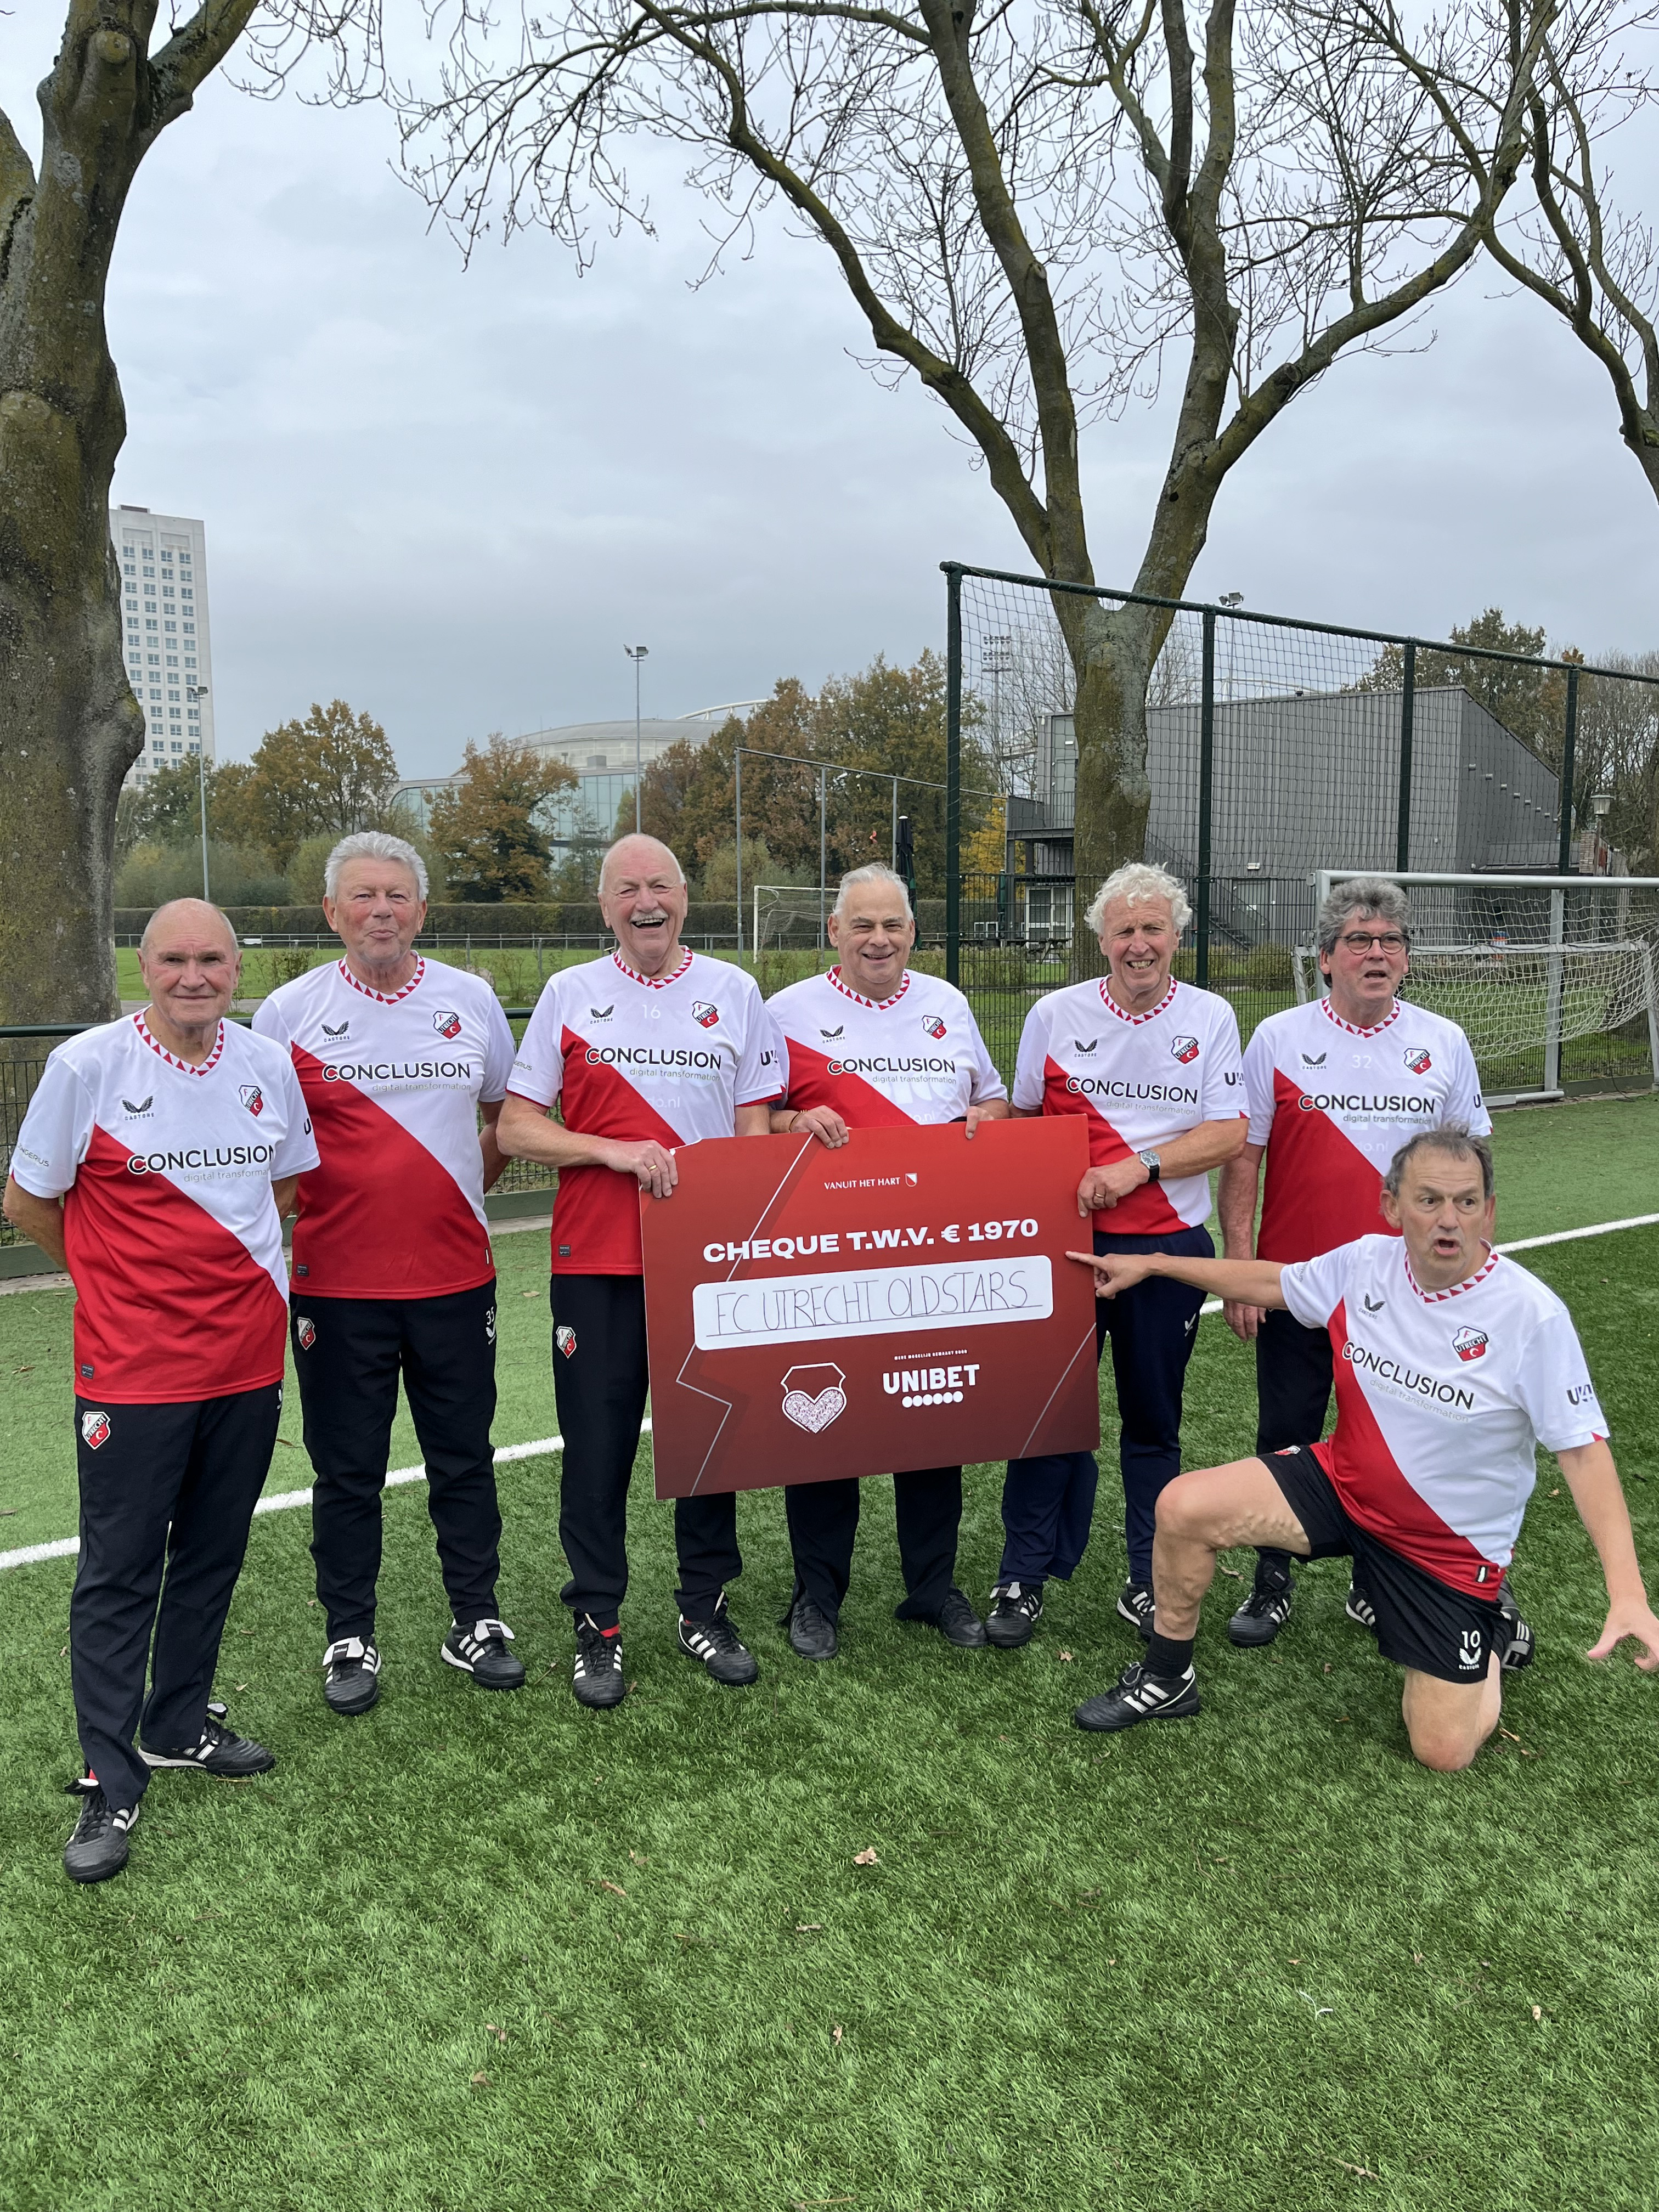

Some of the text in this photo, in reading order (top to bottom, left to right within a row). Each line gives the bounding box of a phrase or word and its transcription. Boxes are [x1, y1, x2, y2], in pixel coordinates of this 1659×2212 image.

[642, 1005, 661, 1019] 16
[586, 1047, 721, 1070] CONCLUSION
[828, 1057, 956, 1075] CONCLUSION
[1352, 1054, 1372, 1069] 32
[323, 1062, 471, 1081] CONCLUSION
[629, 1068, 720, 1082] digital transformation
[373, 1082, 471, 1092] digital transformation
[900, 1075, 956, 1085] transformation
[1066, 1076, 1198, 1104] CONCLUSION
[253, 1102, 260, 1111] C
[1106, 1100, 1195, 1115] digital transformation
[1299, 1094, 1435, 1114] CONCLUSION
[1343, 1114, 1431, 1125] digital transformation
[184, 1172, 215, 1183] digital
[824, 1177, 901, 1190] VANUIT HET HART
[703, 1218, 1039, 1263] CHEQUE T.W.V. € 1970
[716, 1293, 752, 1335] FC
[763, 1280, 879, 1331] UTRECHT
[1463, 1330, 1471, 1339] F
[1454, 1334, 1487, 1353] UTRECHT
[1469, 1347, 1479, 1357] C
[883, 1364, 980, 1395] UNIBET
[1343, 1341, 1475, 1410] CONCLUSION
[1369, 1378, 1469, 1423] digital transformation
[95, 1431, 103, 1440] C
[1462, 1630, 1481, 1649] 10
